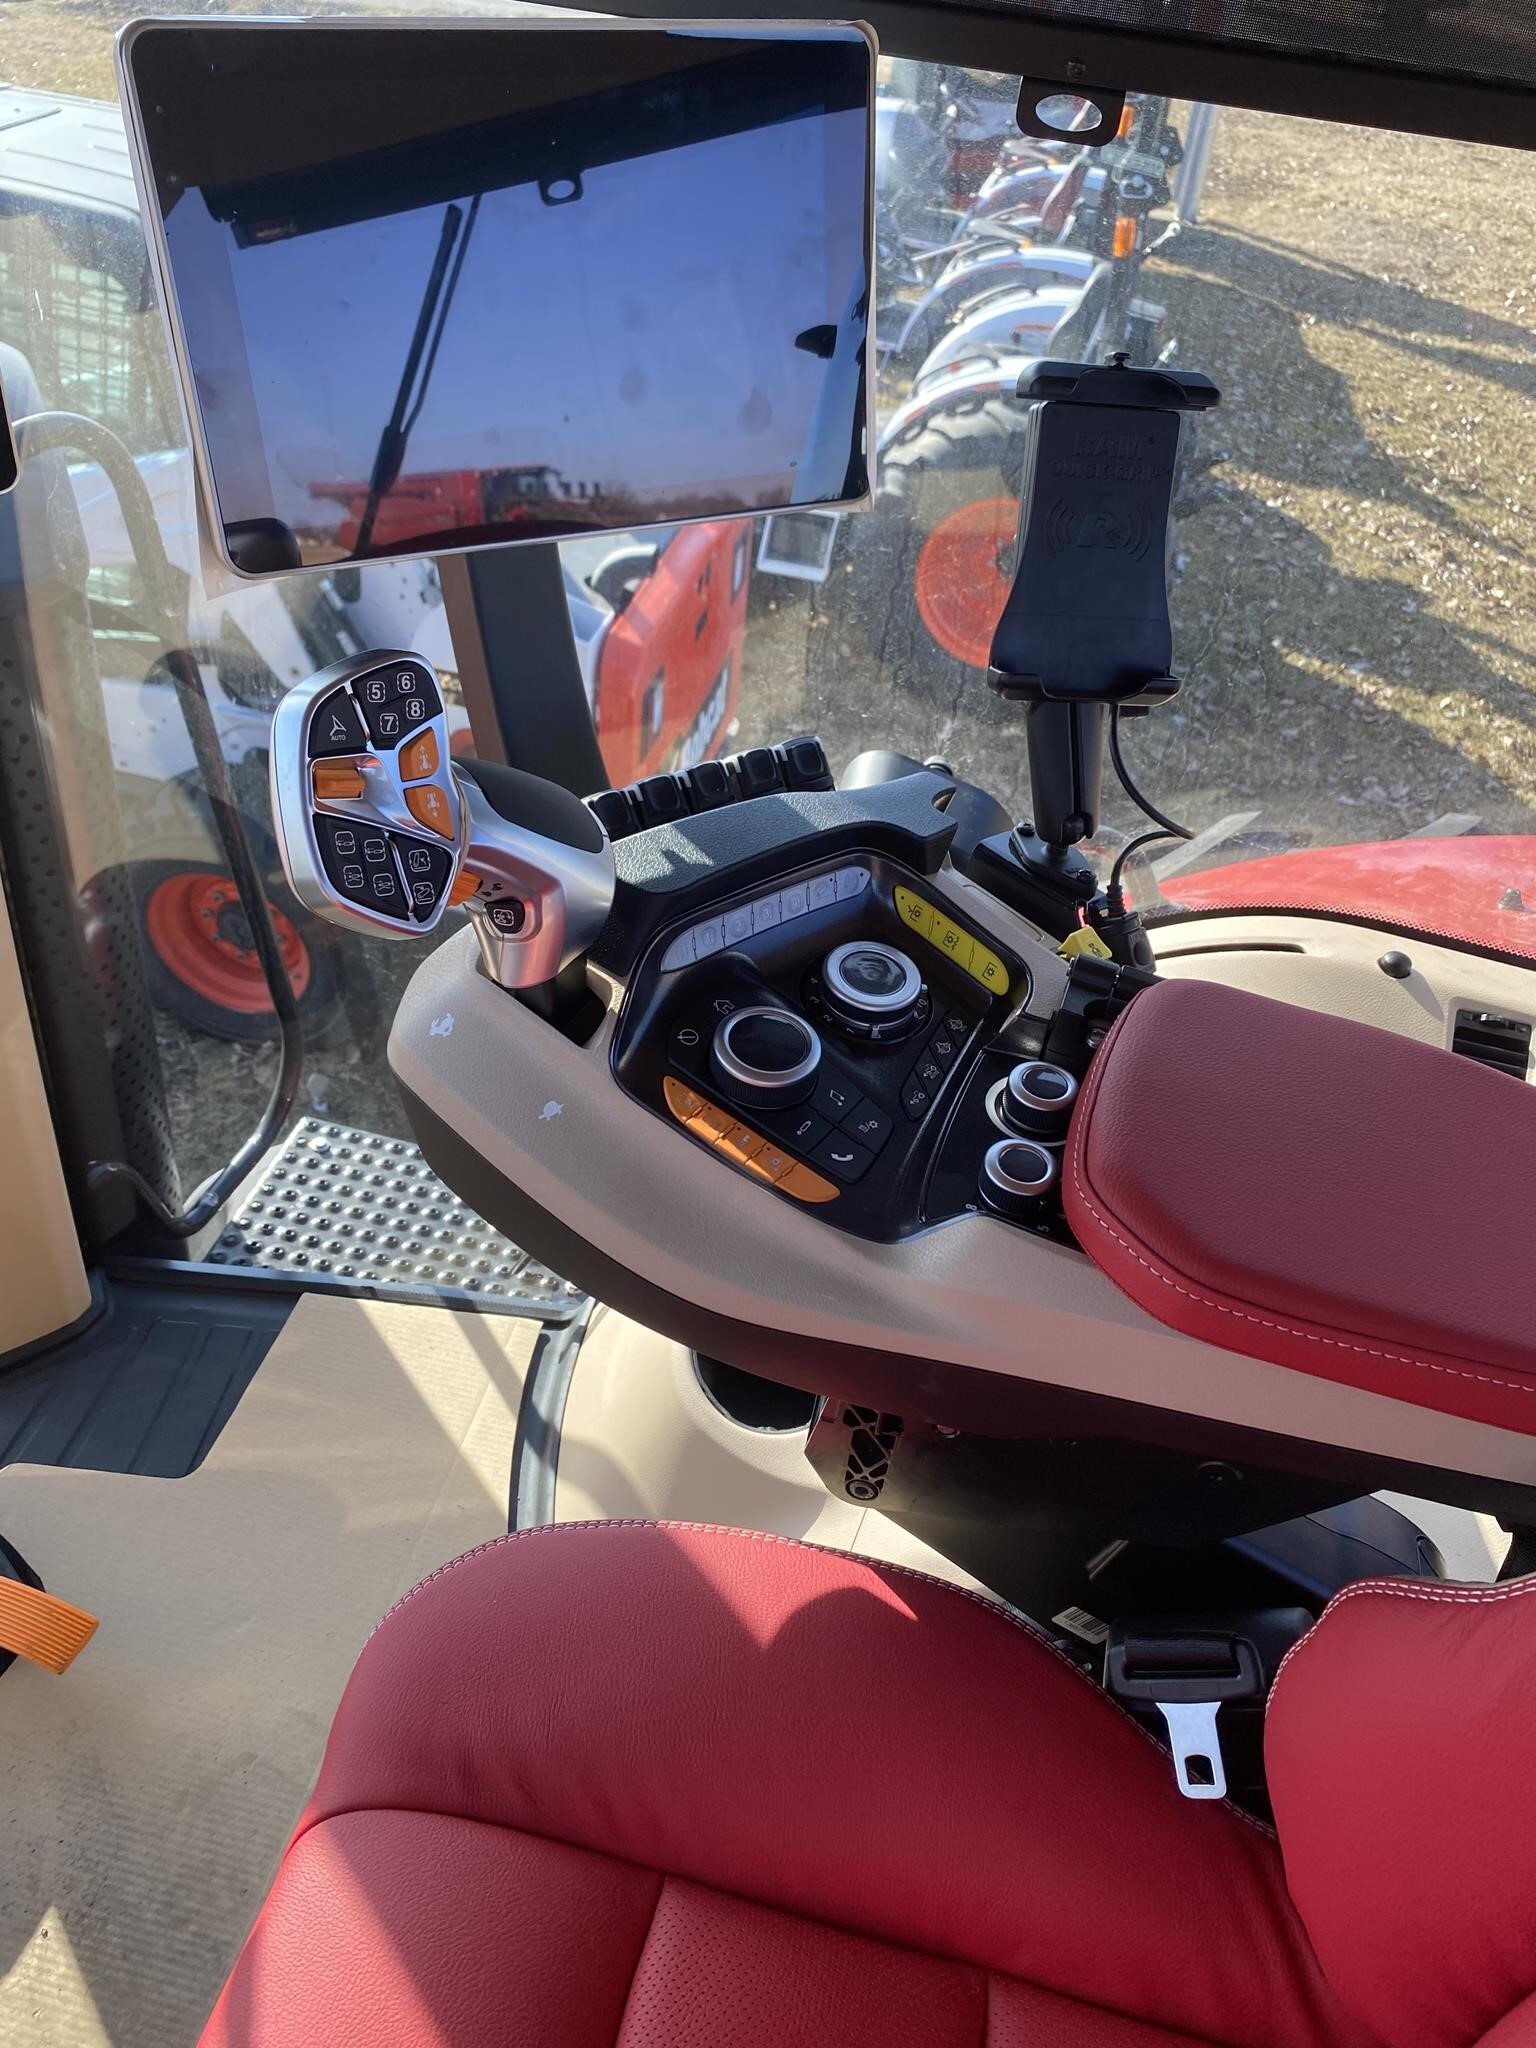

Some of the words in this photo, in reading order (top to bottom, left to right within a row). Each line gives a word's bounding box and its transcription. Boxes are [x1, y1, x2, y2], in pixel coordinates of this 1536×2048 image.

[371, 684, 381, 700] 5
[401, 674, 411, 690] 6
[383, 715, 394, 732] 7
[411, 701, 421, 717] 8
[330, 734, 346, 742] AUTO
[916, 997, 928, 1008] 10
[965, 1202, 978, 1211] 8
